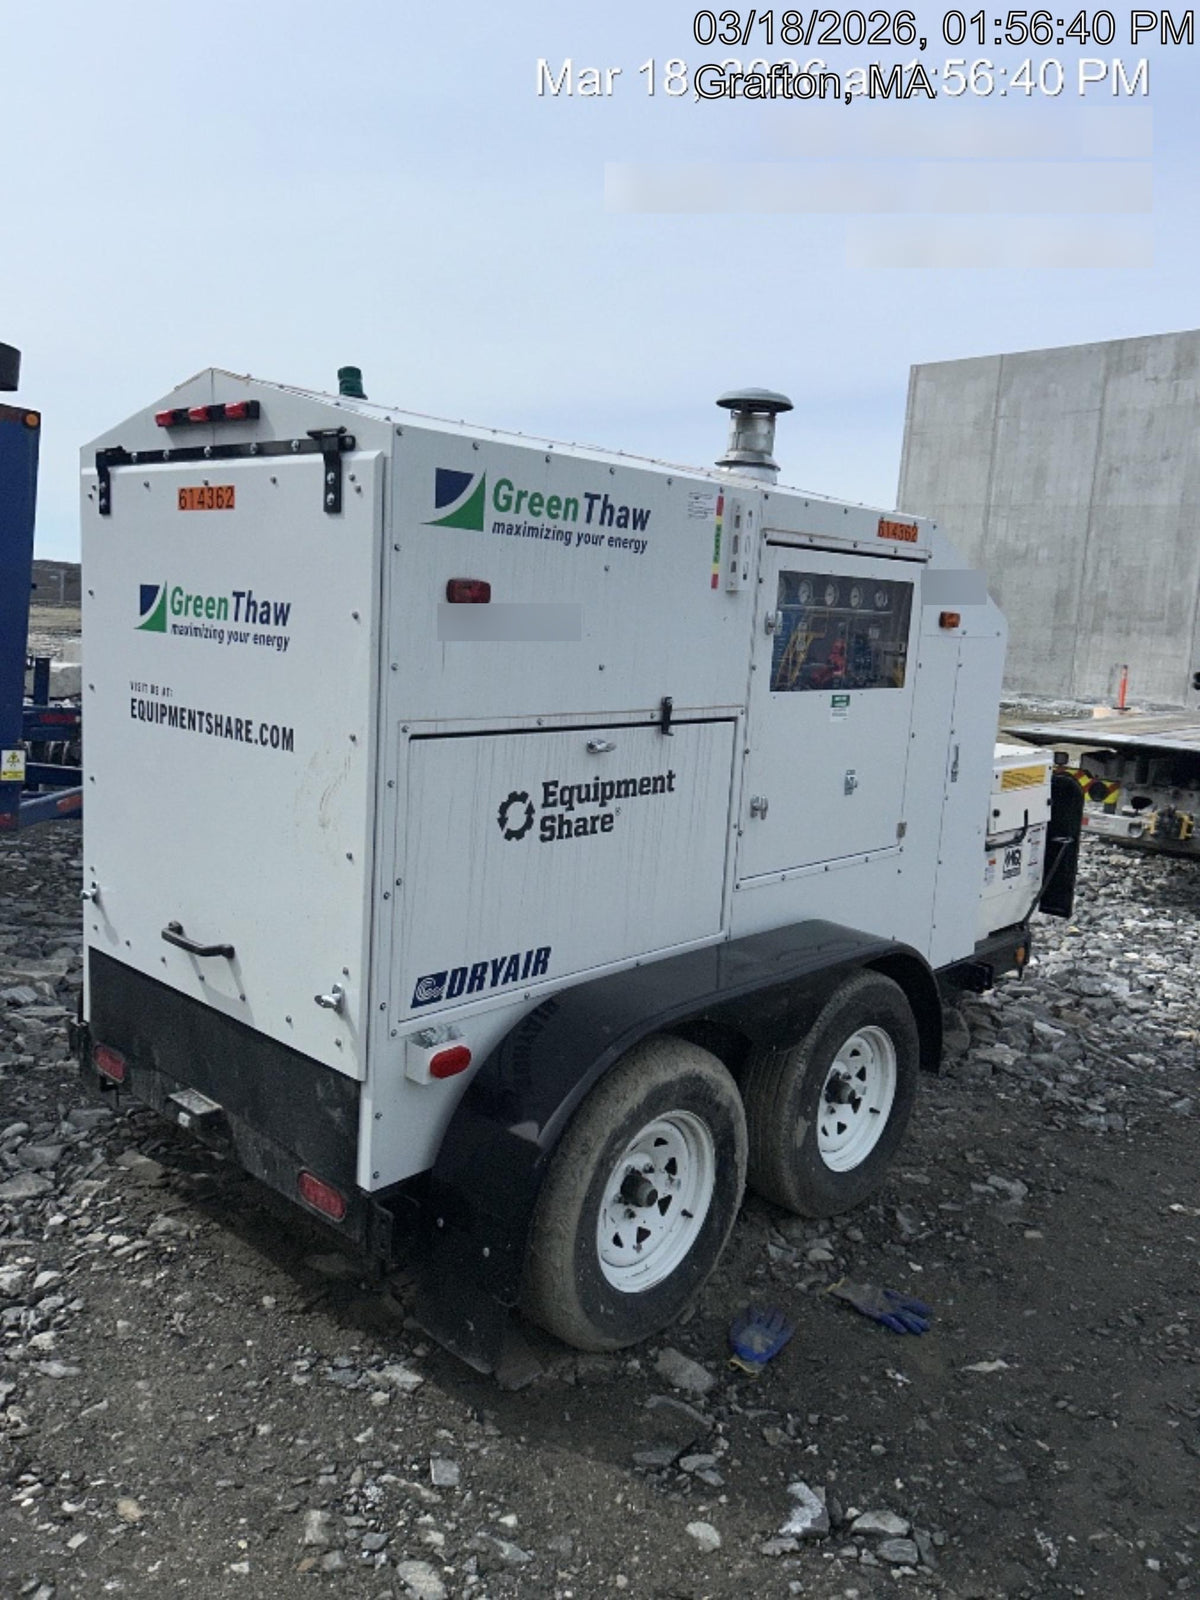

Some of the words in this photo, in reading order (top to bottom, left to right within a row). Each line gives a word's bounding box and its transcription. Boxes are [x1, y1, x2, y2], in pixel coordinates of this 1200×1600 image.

[178, 486, 235, 510] 614362
[492, 520, 573, 547] maximizing
[575, 531, 605, 547] your
[607, 535, 648, 555] energy
[171, 622, 225, 645] maximizing
[226, 629, 251, 645] your
[252, 632, 291, 652] energy
[130, 698, 295, 752] EQUIPMENTSHARE.COM
[541, 769, 677, 812] Equipment
[445, 946, 552, 1000] DRYAIR
